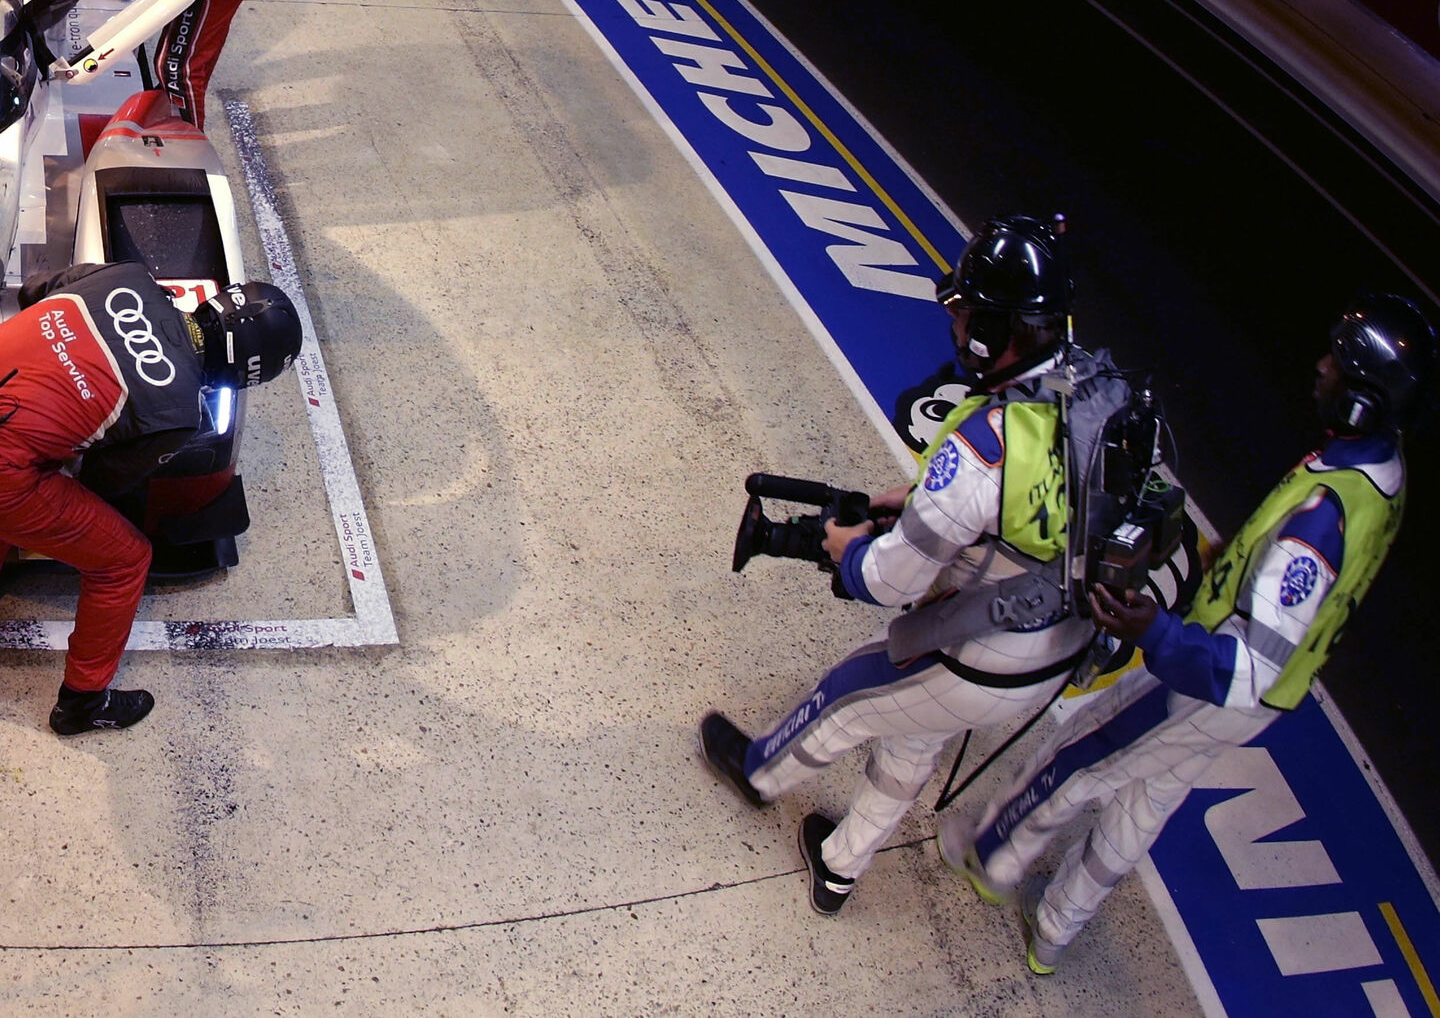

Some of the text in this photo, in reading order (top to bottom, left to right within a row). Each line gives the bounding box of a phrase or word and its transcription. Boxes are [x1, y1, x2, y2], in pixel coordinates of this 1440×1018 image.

[167, 11, 193, 91] Audi Sport
[51, 310, 77, 344] Audi
[38, 312, 95, 402] Top Service
[300, 352, 316, 397] Audi Sport
[312, 352, 324, 373] Joest
[339, 513, 359, 568] Audi Sport
[355, 511, 372, 568] Team Joest
[245, 624, 288, 634] Sport
[253, 636, 290, 645] Joest
